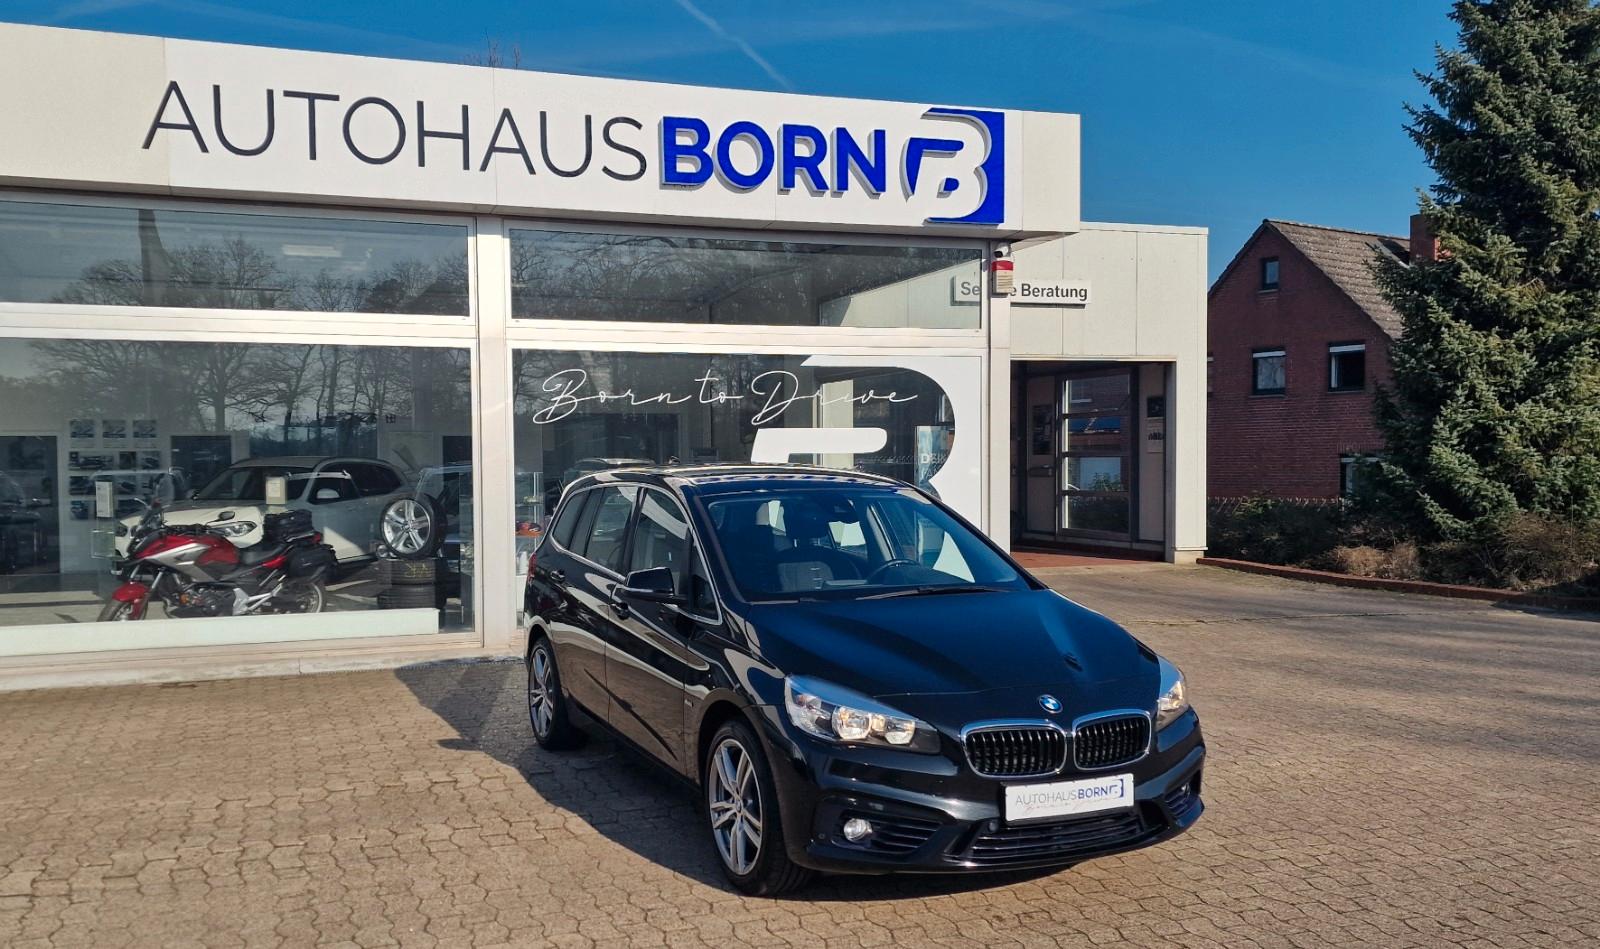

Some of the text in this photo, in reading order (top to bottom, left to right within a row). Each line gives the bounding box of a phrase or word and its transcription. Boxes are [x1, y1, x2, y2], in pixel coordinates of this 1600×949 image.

[1021, 283, 1088, 301] Beratung
[533, 368, 918, 426] Born to Drive
